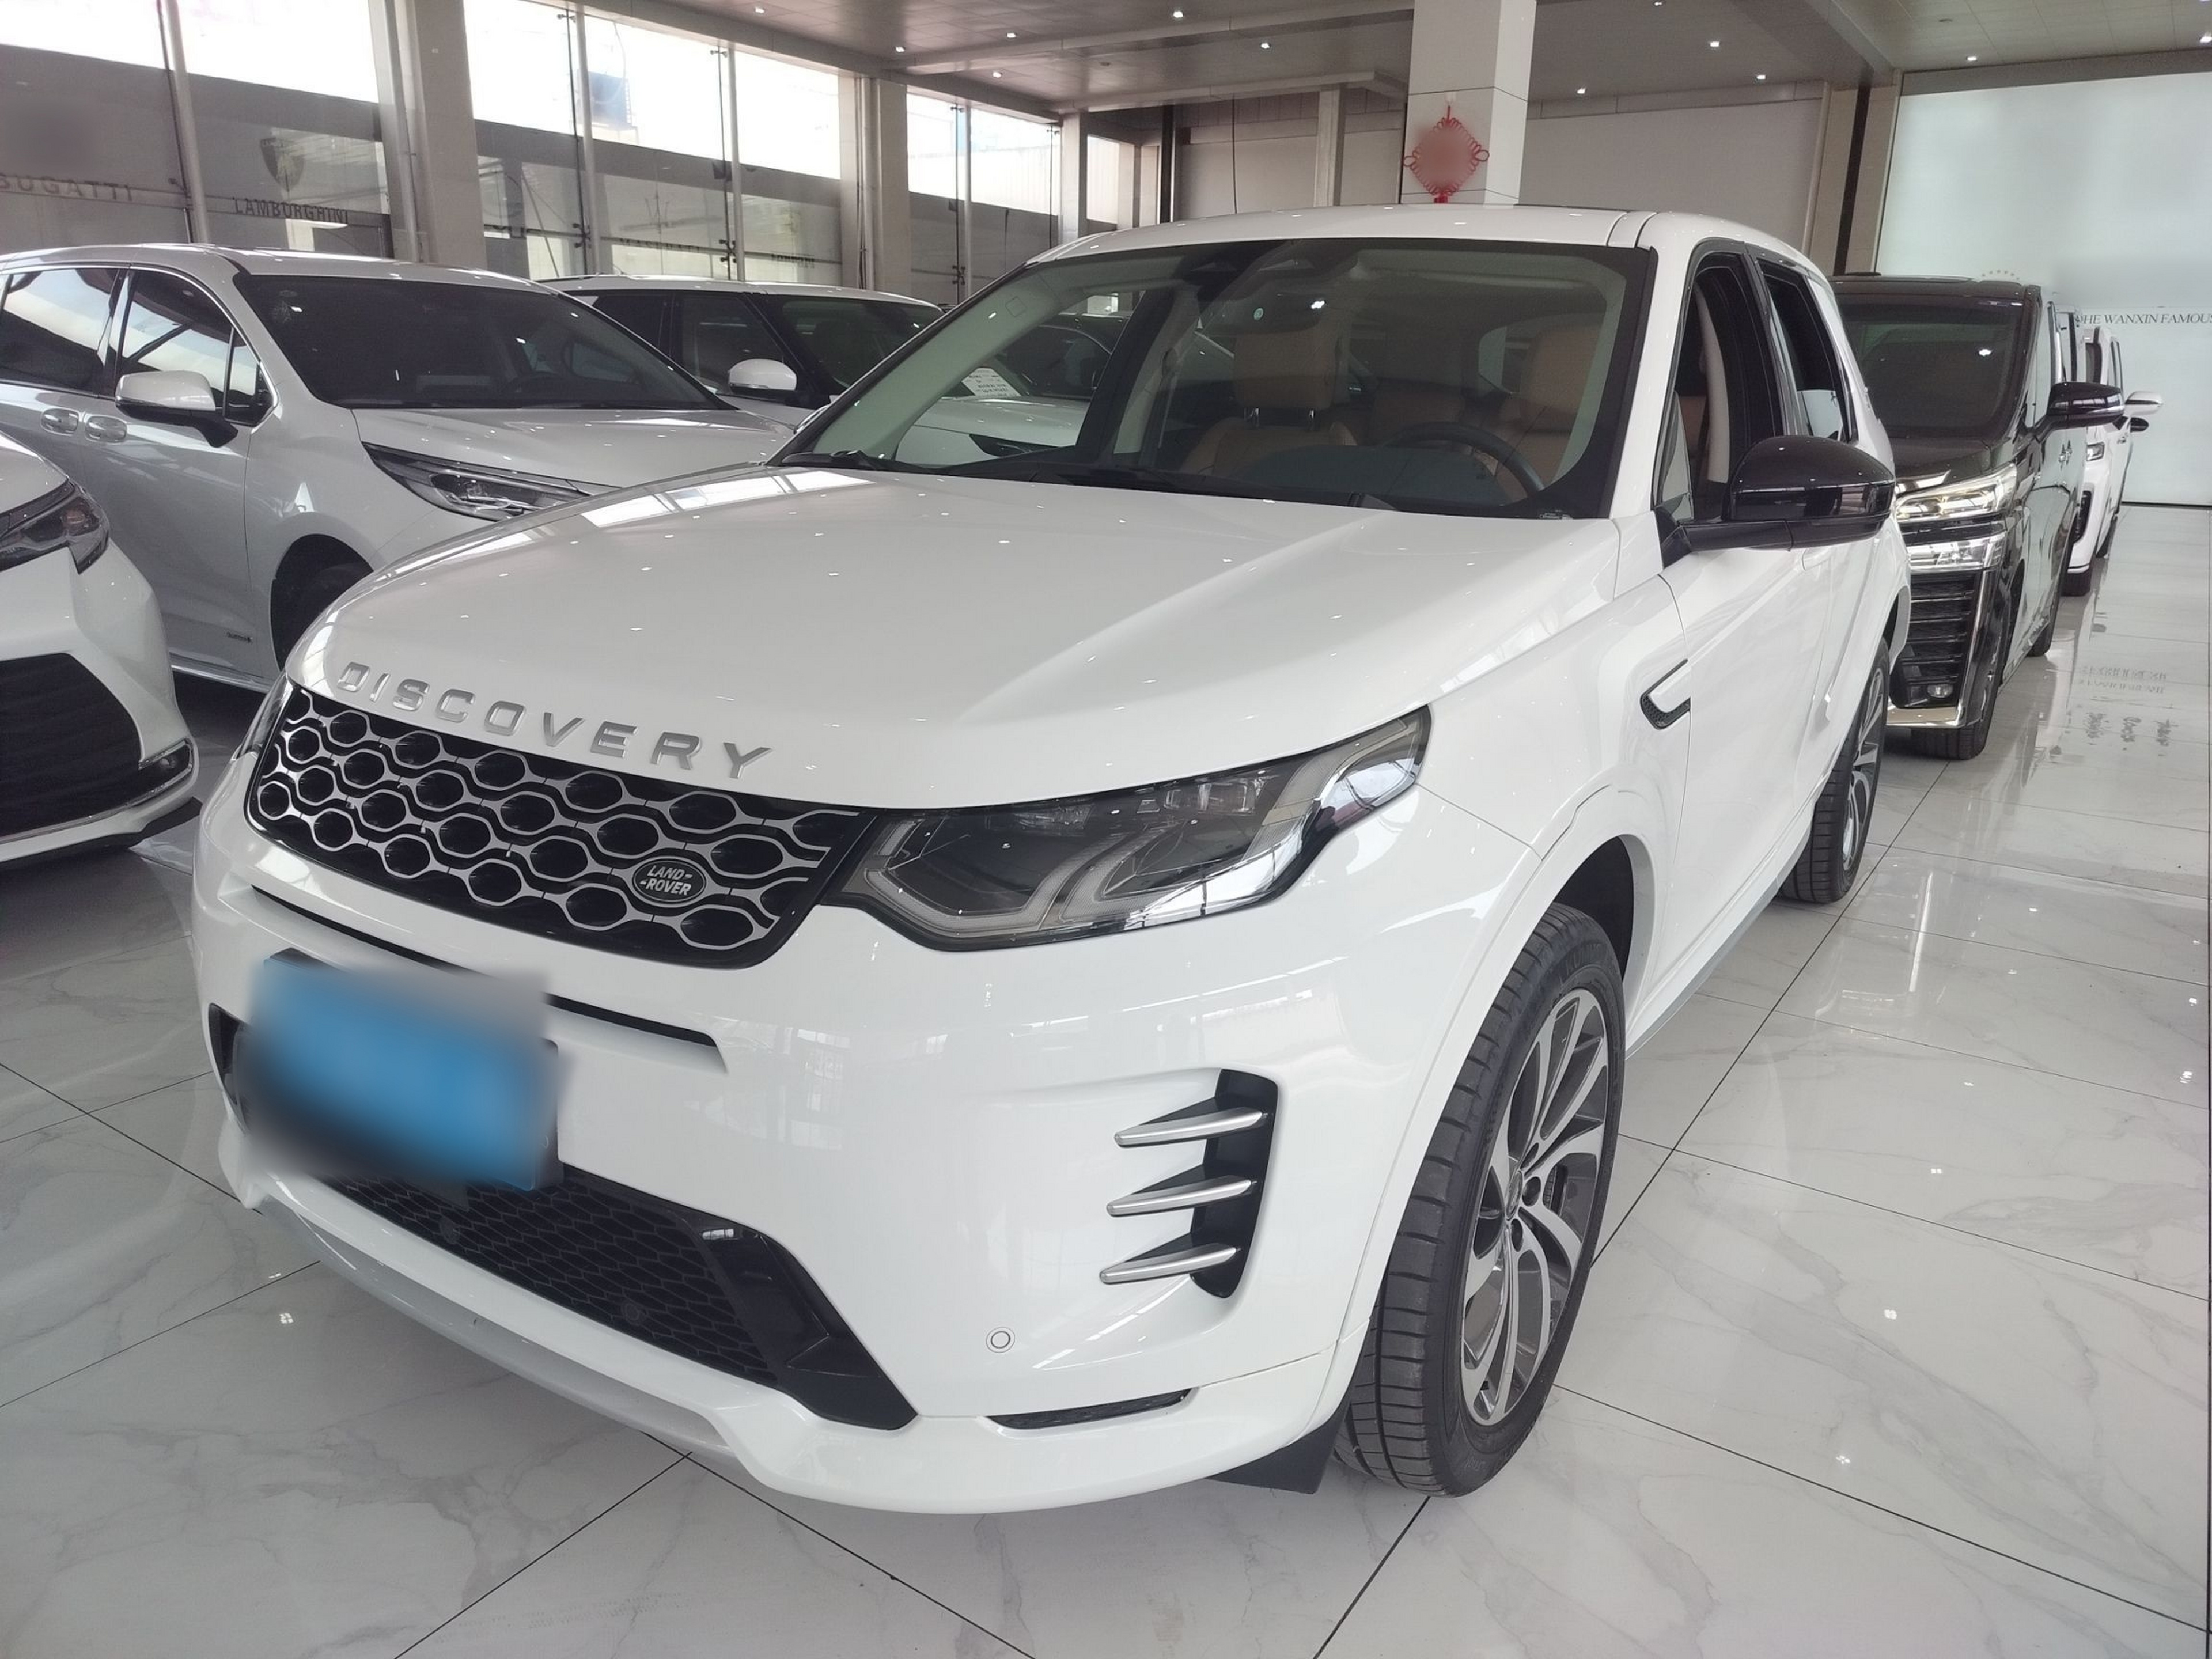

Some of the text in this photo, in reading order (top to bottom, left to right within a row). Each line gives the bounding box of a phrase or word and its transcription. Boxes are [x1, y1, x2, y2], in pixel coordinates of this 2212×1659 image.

[232, 197, 349, 224] LAMBORGHINI
[2077, 315, 2102, 324] HE
[2104, 314, 2158, 324] WANXIN
[336, 661, 772, 780] DISCOVERY
